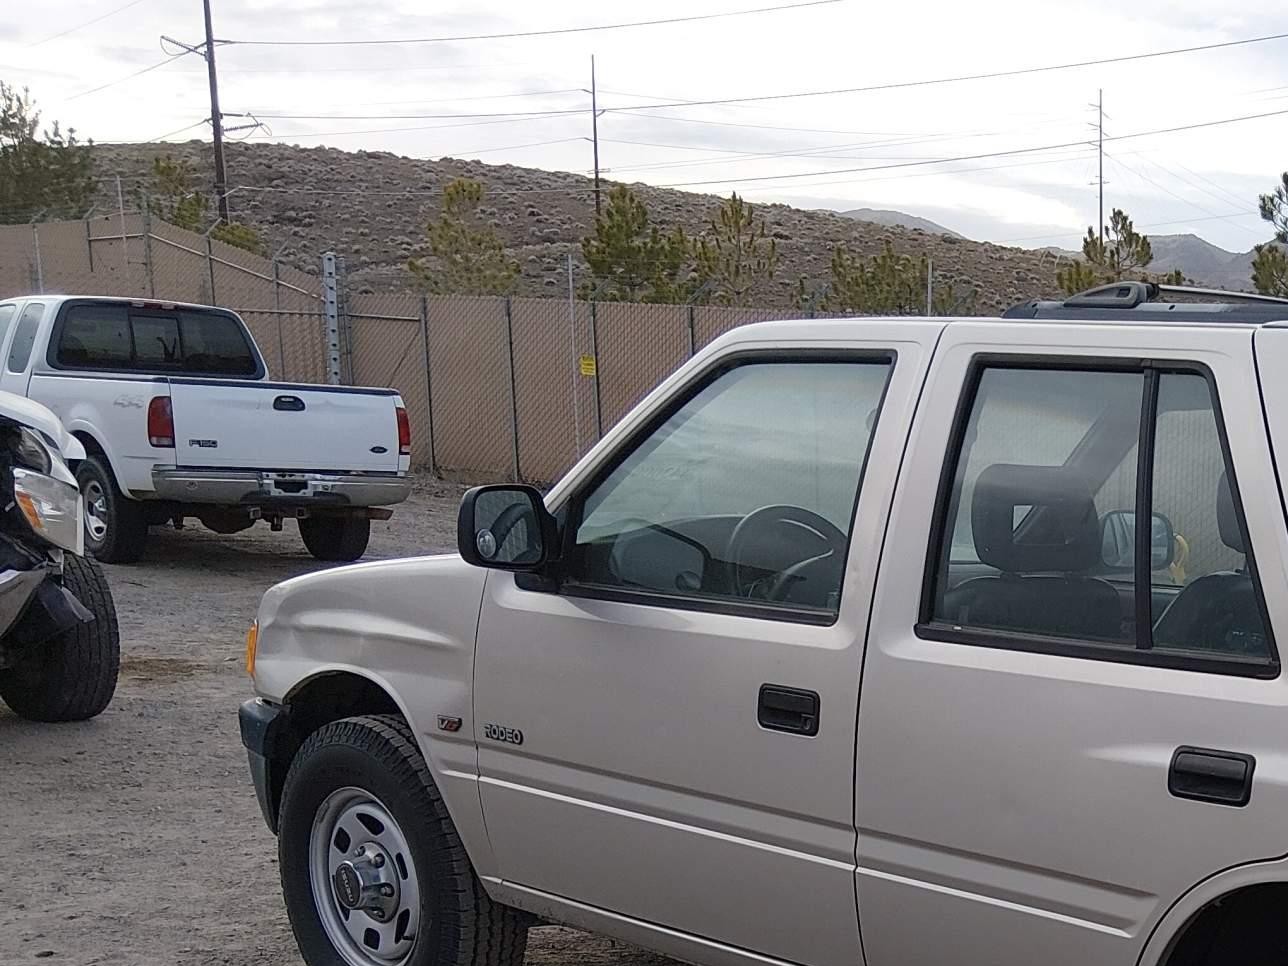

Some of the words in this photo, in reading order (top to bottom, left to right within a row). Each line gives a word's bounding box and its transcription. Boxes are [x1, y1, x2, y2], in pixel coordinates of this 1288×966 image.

[438, 714, 462, 732] V6
[484, 724, 524, 745] RODEO
[341, 869, 354, 902] ISUZU
